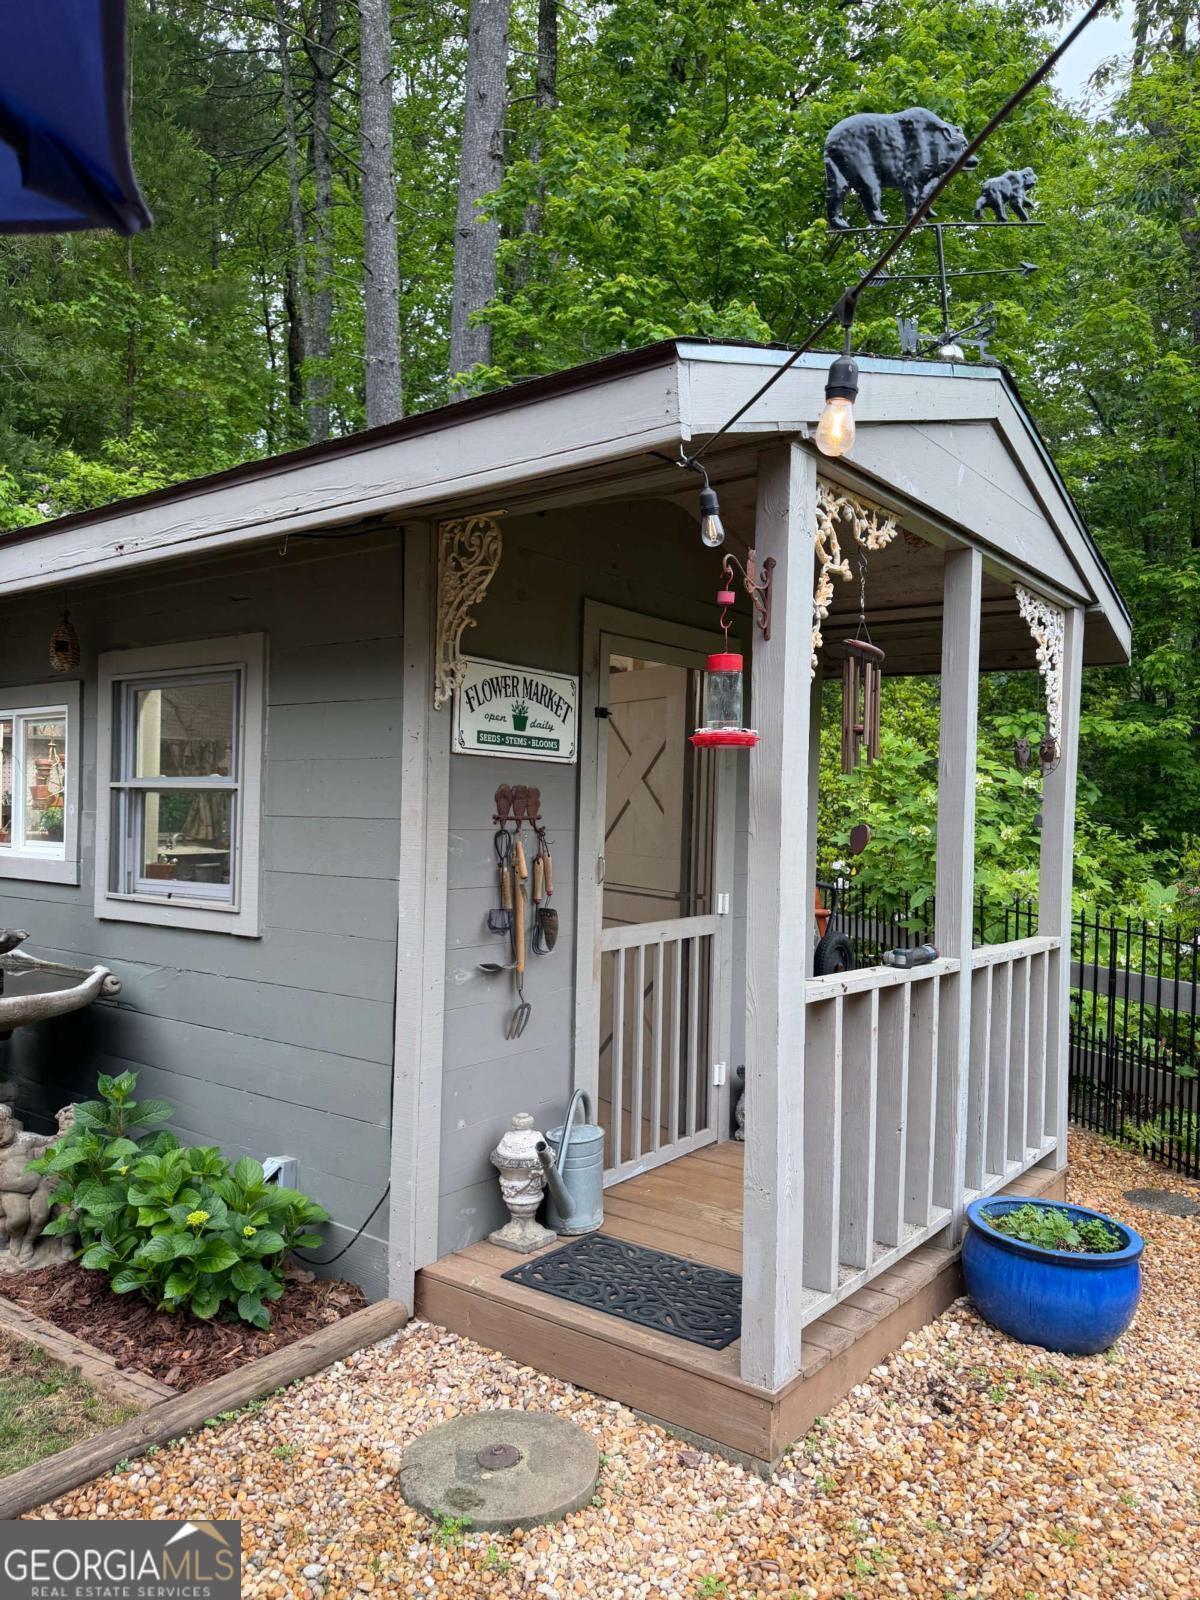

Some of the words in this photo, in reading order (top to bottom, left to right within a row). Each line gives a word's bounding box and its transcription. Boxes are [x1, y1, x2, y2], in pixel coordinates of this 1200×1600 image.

[464, 675, 520, 713] FLOWER
[522, 677, 573, 725] MARKET
[484, 712, 507, 722] open
[530, 719, 555, 732] daily
[479, 732, 501, 742] SEEDS
[505, 735, 527, 745] STEMS
